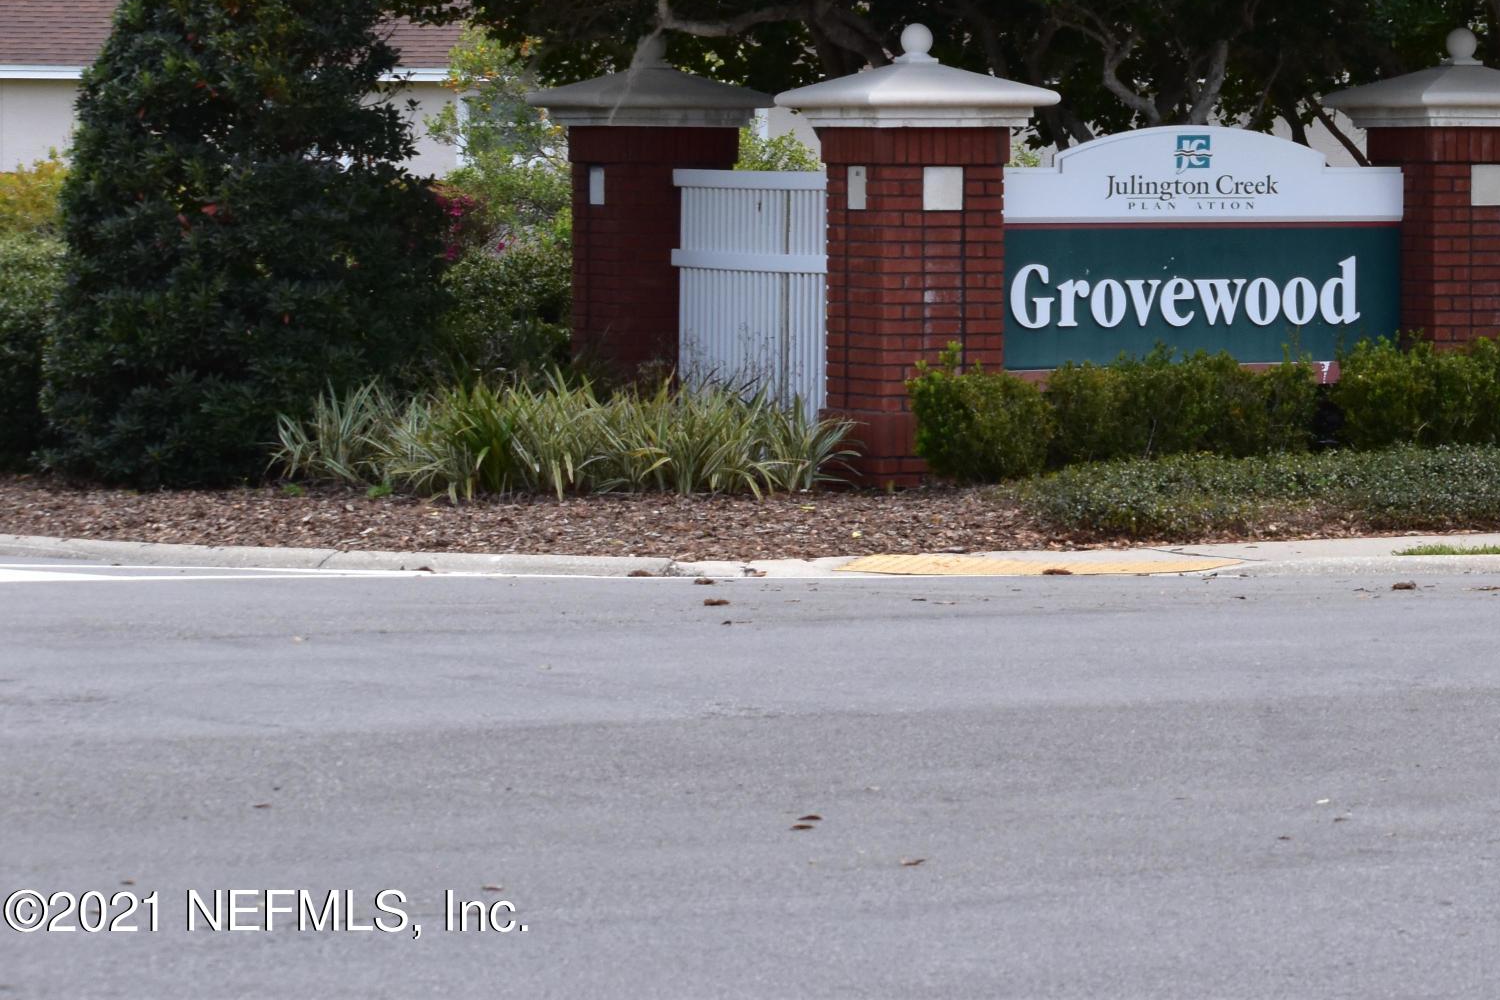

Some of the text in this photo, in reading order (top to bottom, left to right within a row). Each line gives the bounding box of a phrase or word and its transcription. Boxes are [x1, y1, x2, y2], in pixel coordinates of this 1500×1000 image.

[1105, 174, 1279, 201] Julington Creek
[1010, 256, 1361, 328] Grovewood
